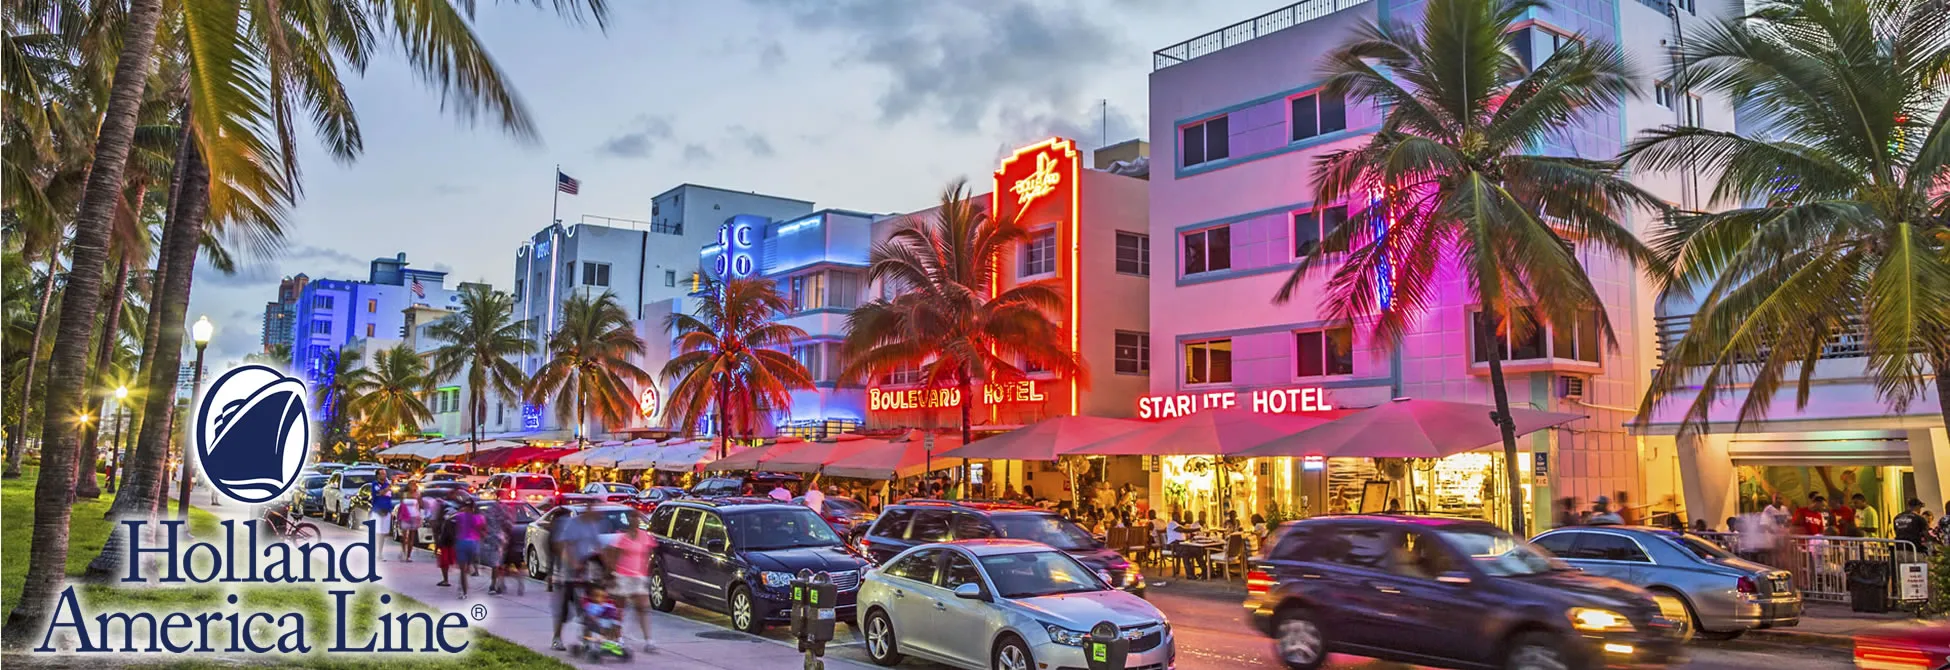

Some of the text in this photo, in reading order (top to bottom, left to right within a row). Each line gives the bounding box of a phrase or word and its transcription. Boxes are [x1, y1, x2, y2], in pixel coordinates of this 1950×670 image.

[870, 381, 1044, 410] BOULEVARD HOTEL
[1253, 387, 1332, 414] HOTEL
